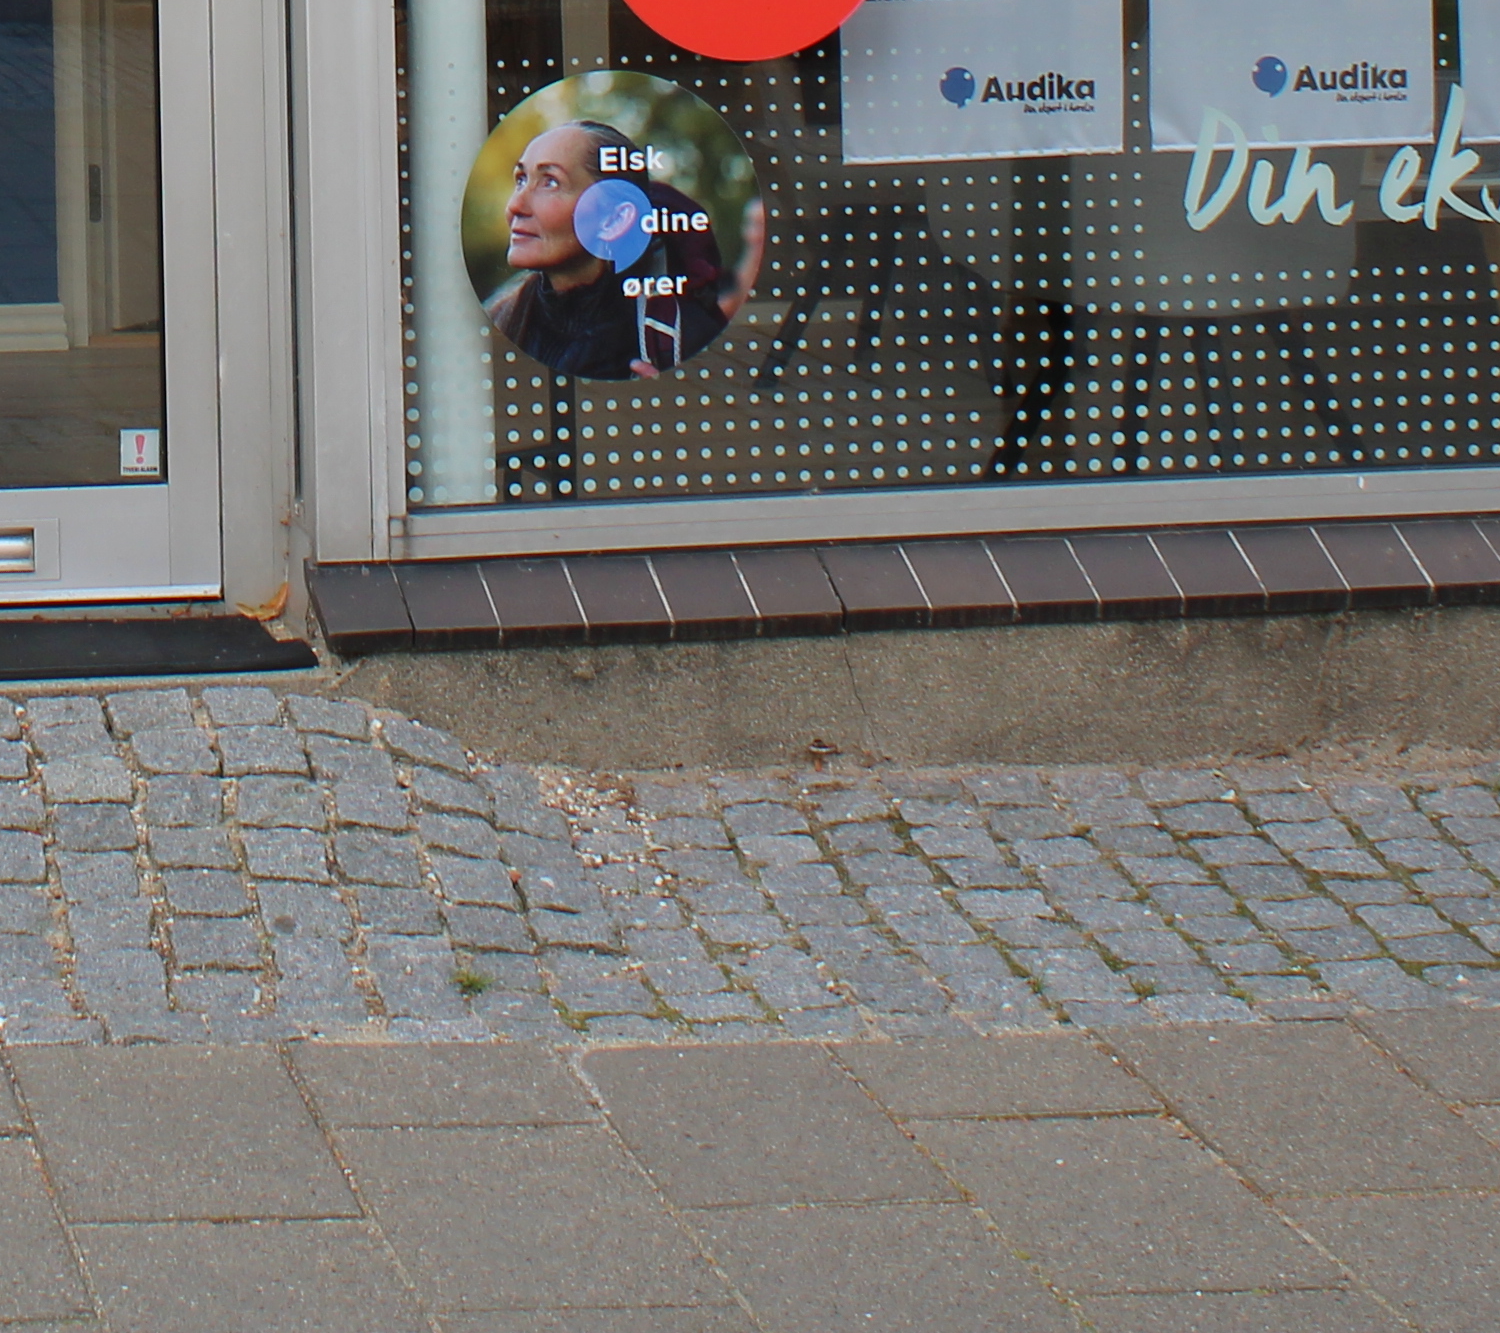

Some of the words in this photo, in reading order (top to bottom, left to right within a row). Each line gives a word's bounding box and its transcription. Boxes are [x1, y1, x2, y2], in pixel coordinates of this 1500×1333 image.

[981, 72, 1095, 102] Audika
[1293, 61, 1407, 92] Audika
[600, 146, 664, 172] Elsk
[1184, 106, 1355, 231] Din
[640, 209, 709, 233] dine
[622, 275, 688, 297] ører
